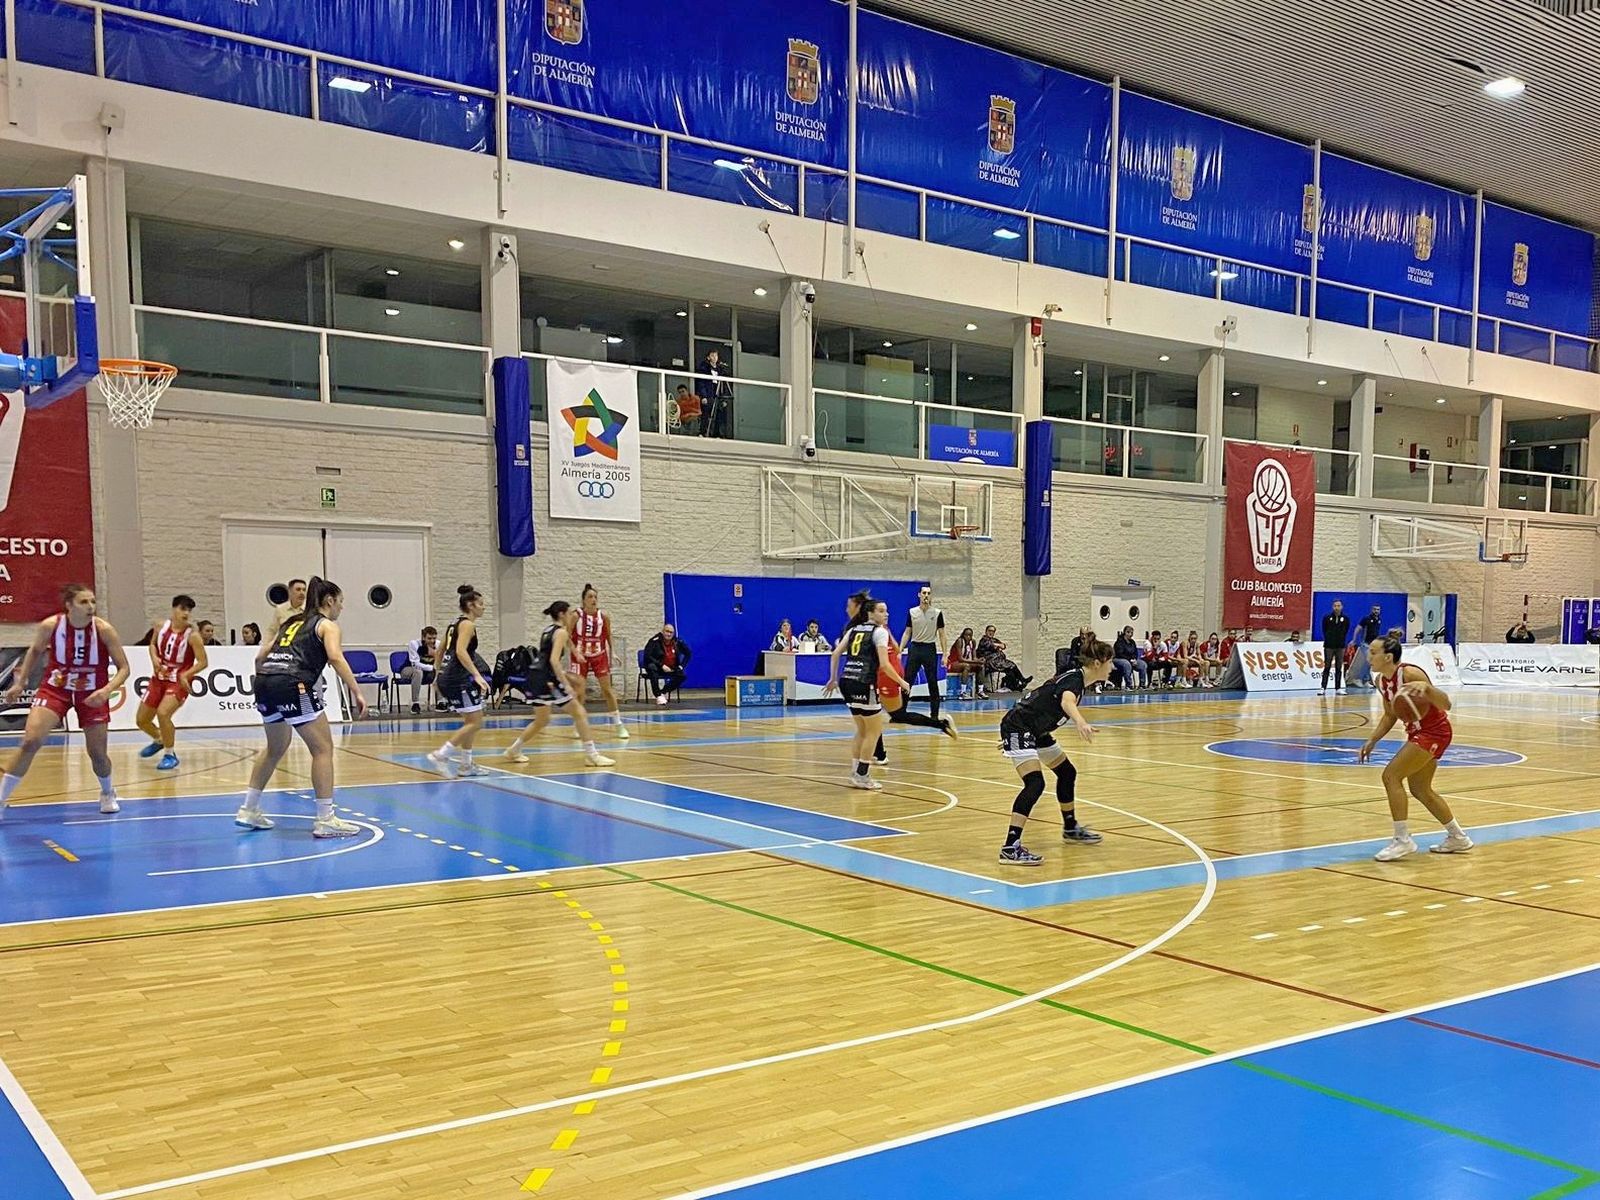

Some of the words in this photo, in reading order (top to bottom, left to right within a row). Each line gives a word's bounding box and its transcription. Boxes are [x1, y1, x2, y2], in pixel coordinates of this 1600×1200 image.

[532, 53, 595, 76] DIPUTACIÓN
[534, 65, 546, 77] DE
[549, 68, 593, 88] ALMERÍA
[775, 111, 826, 131] DIPUTACIÓN
[776, 122, 787, 132] DE
[788, 126, 824, 141] ALMERÍA
[979, 160, 1020, 178] DIPUTACIÓN
[979, 171, 988, 180] DE
[989, 173, 1019, 187] ALMERÍA
[1162, 206, 1197, 221] DIPUTACIÓN
[1170, 218, 1196, 230] ALMERÍA
[944, 446, 972, 455] DIPUTACIÓN
[561, 467, 601, 480] Almería
[605, 470, 631, 482] 2005
[1231, 579, 1254, 591] CLUB
[1254, 581, 1302, 594] BALONCESTO
[1251, 595, 1284, 607] ALMERÍA
[280, 621, 304, 647] 9
[851, 633, 865, 656] 8
[1488, 665, 1596, 674] ECHEVARNE
